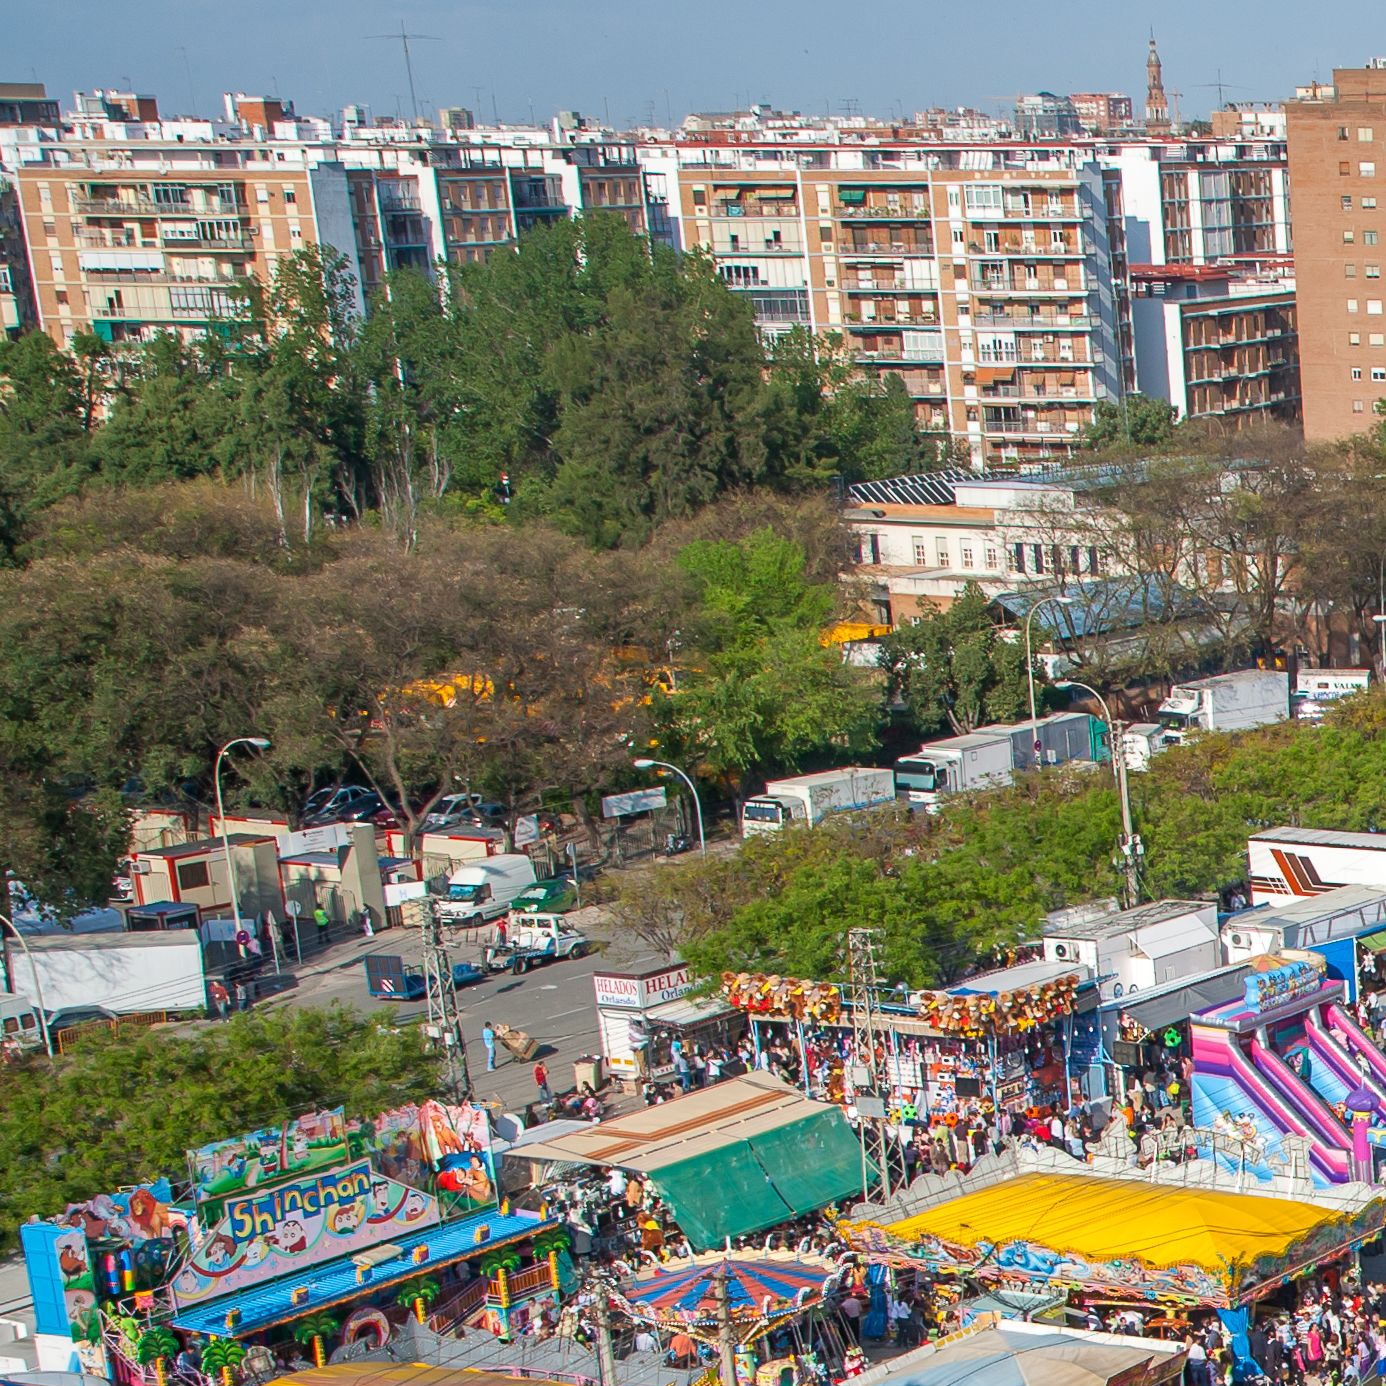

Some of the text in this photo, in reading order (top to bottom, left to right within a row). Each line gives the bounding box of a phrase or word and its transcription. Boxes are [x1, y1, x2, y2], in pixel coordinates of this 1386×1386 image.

[597, 978, 637, 996] HELADOS
[601, 995, 636, 1005] Orlando
[233, 1172, 369, 1238] Shinchan
